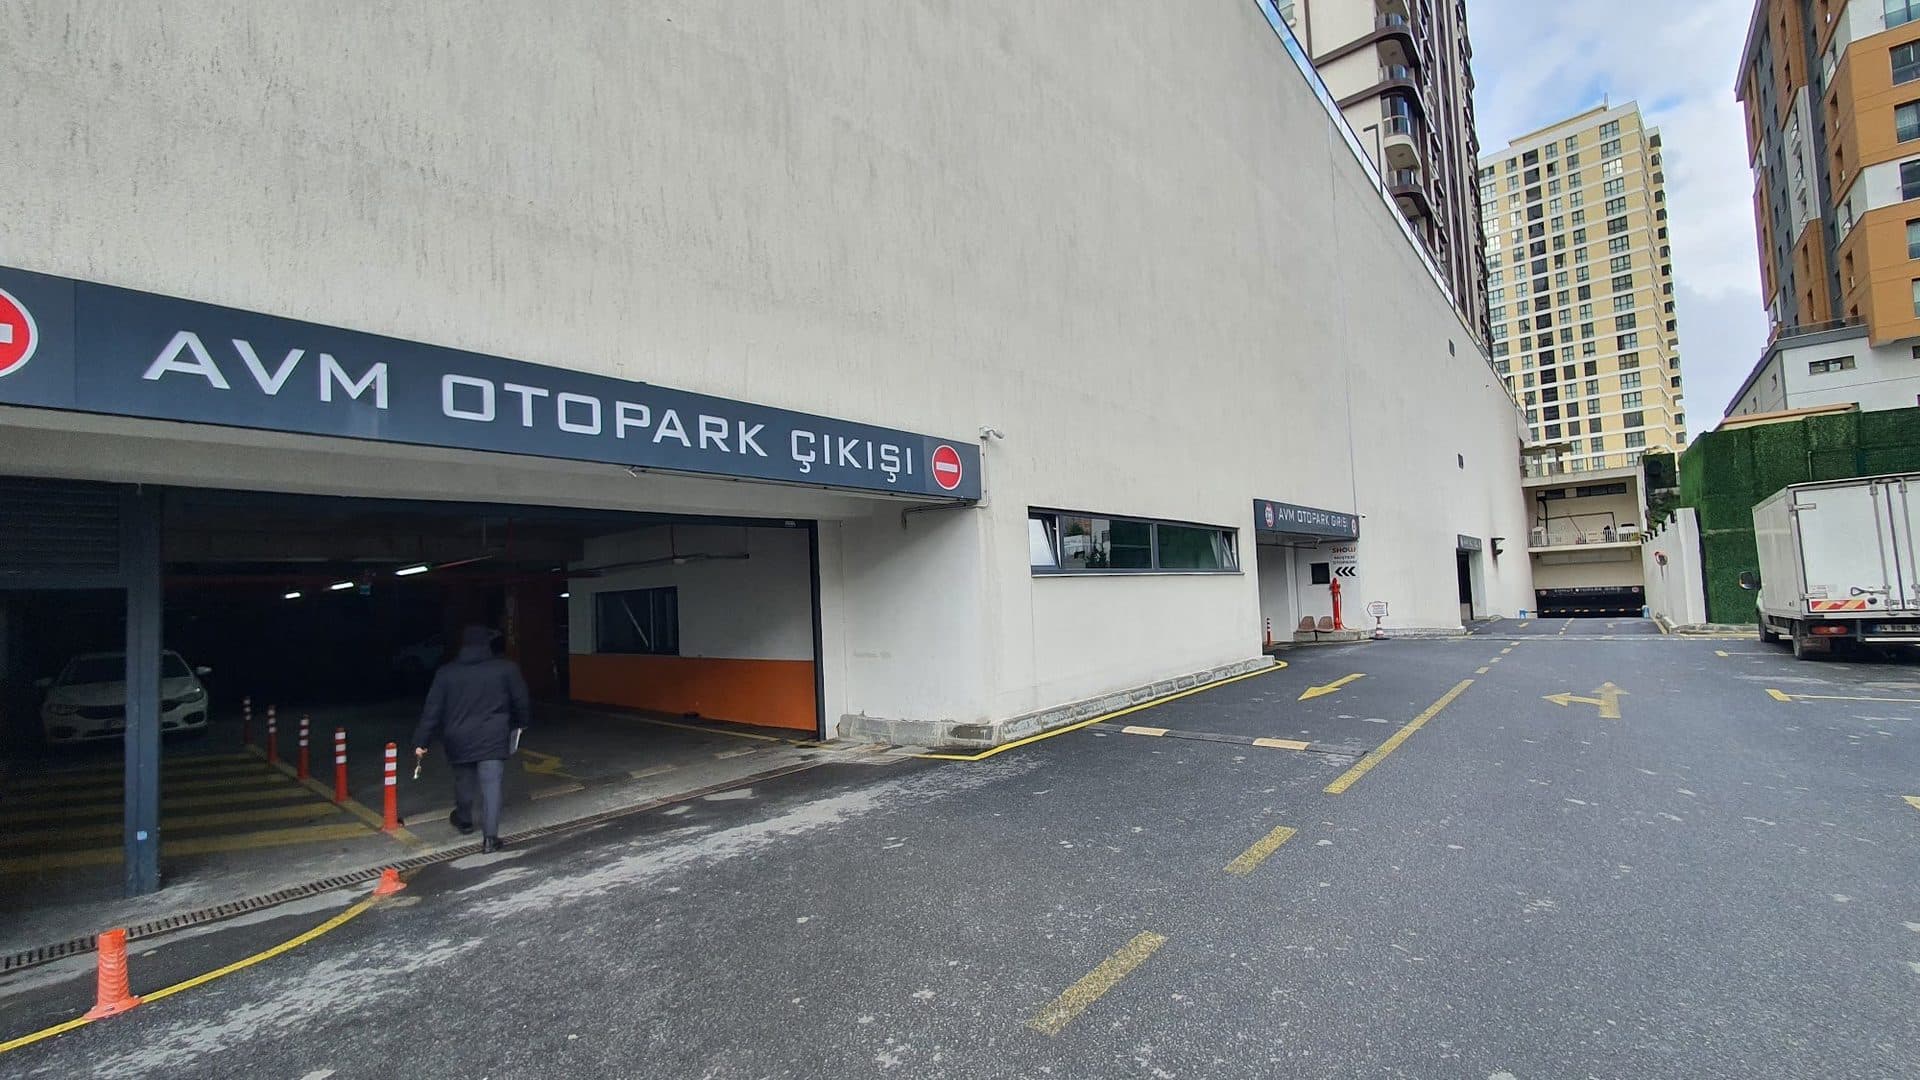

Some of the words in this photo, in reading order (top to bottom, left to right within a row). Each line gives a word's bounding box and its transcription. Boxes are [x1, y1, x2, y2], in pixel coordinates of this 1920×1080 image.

[142, 330, 388, 410] AVM
[442, 374, 768, 457] OTOPARK
[791, 429, 913, 483] ÇIKIŞI
[1279, 508, 1295, 521] AVM
[1297, 511, 1330, 526] OTOPARK
